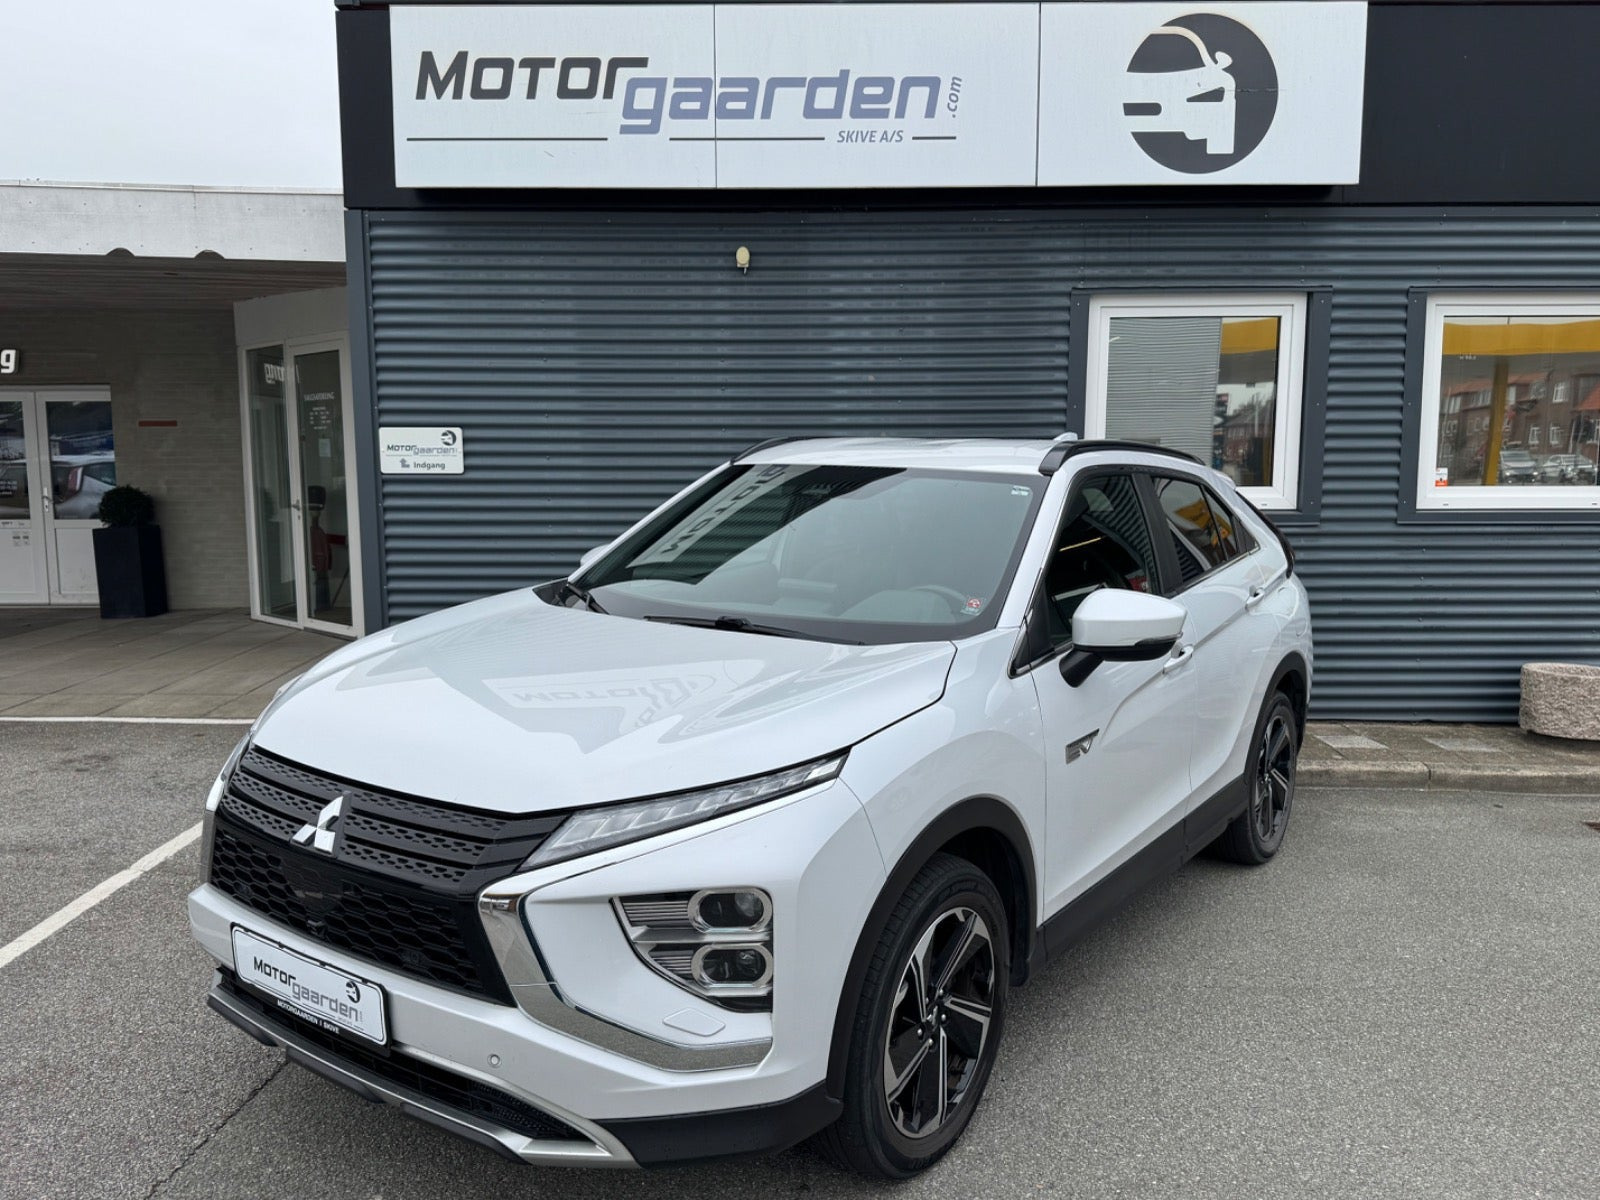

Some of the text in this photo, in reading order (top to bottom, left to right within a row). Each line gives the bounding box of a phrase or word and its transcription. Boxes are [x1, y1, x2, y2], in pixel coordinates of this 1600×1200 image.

[947, 76, 962, 119] .com
[837, 130, 904, 143] SKIVE A/S
[414, 462, 445, 470] Indgang
